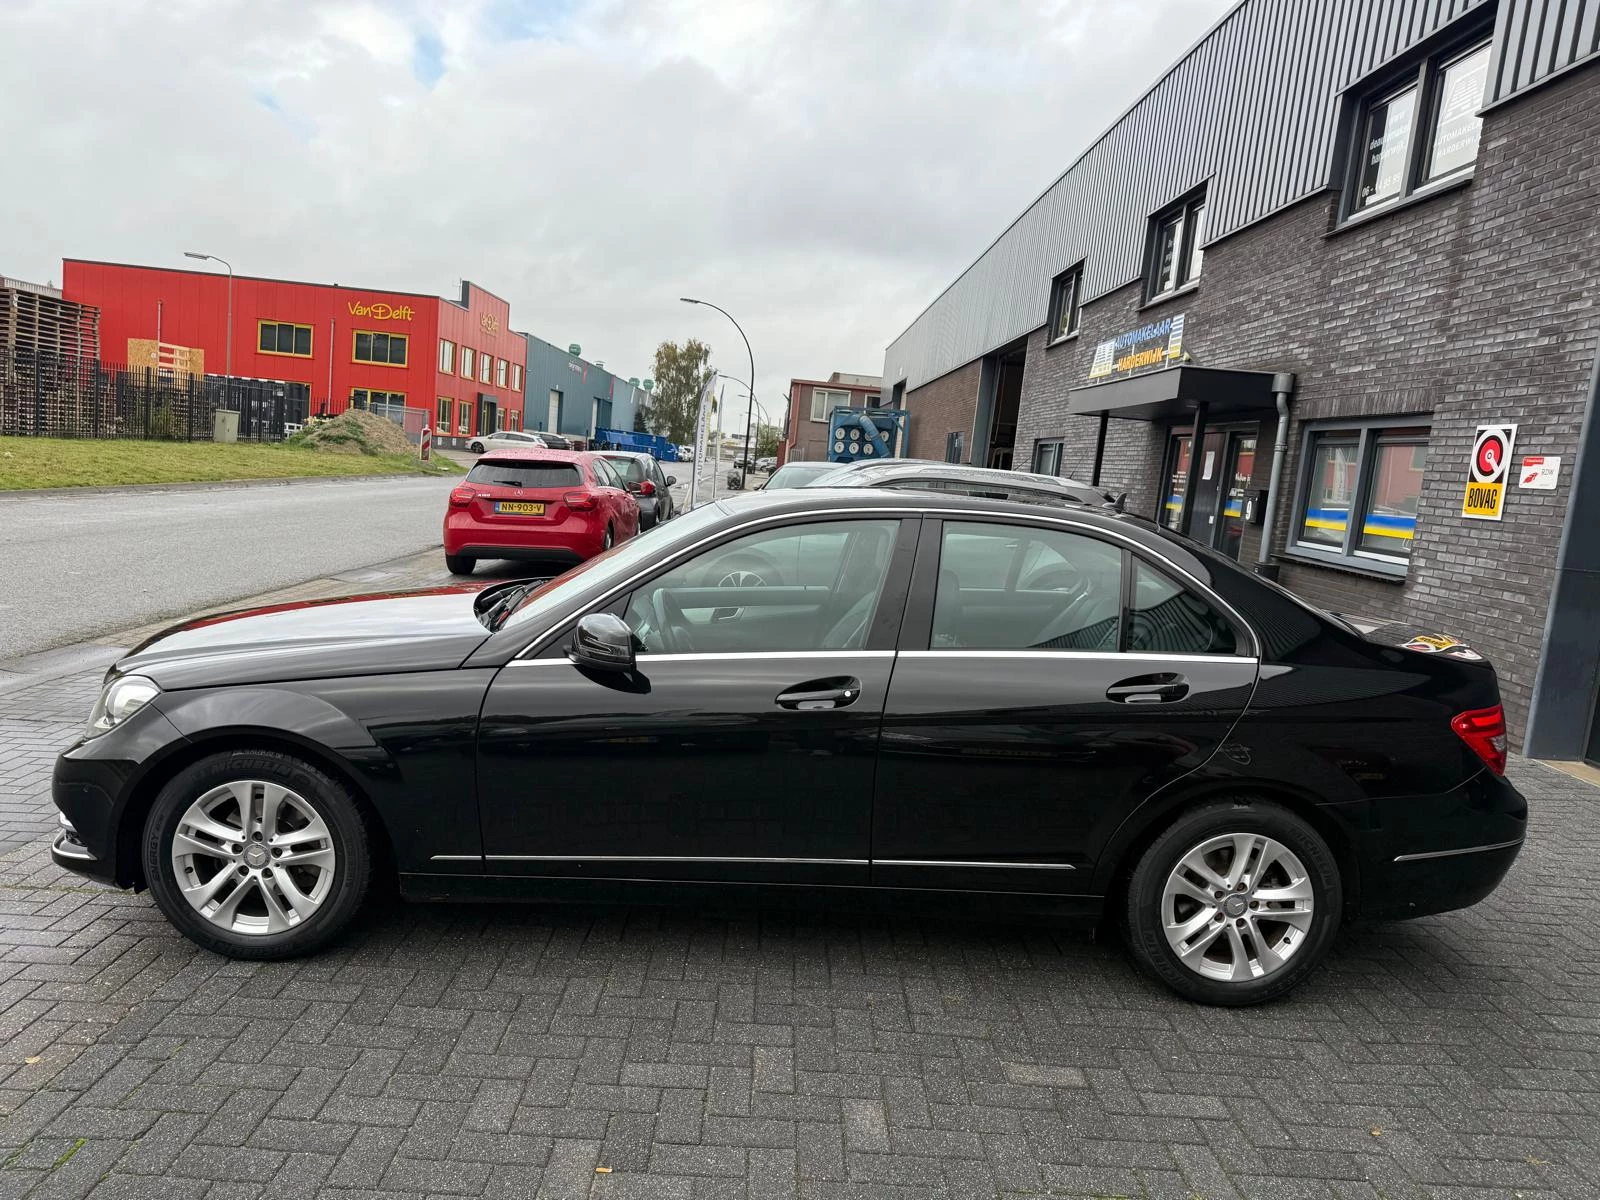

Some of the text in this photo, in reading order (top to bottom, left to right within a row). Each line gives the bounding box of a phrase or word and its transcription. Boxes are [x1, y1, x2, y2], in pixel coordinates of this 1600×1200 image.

[1114, 318, 1171, 349] AUTOMAKELAAR
[1117, 347, 1163, 371] HARDERWIJK
[502, 503, 542, 512] NN-903-V
[1245, 500, 1252, 520] 9
[1467, 488, 1498, 510] BOVAG
